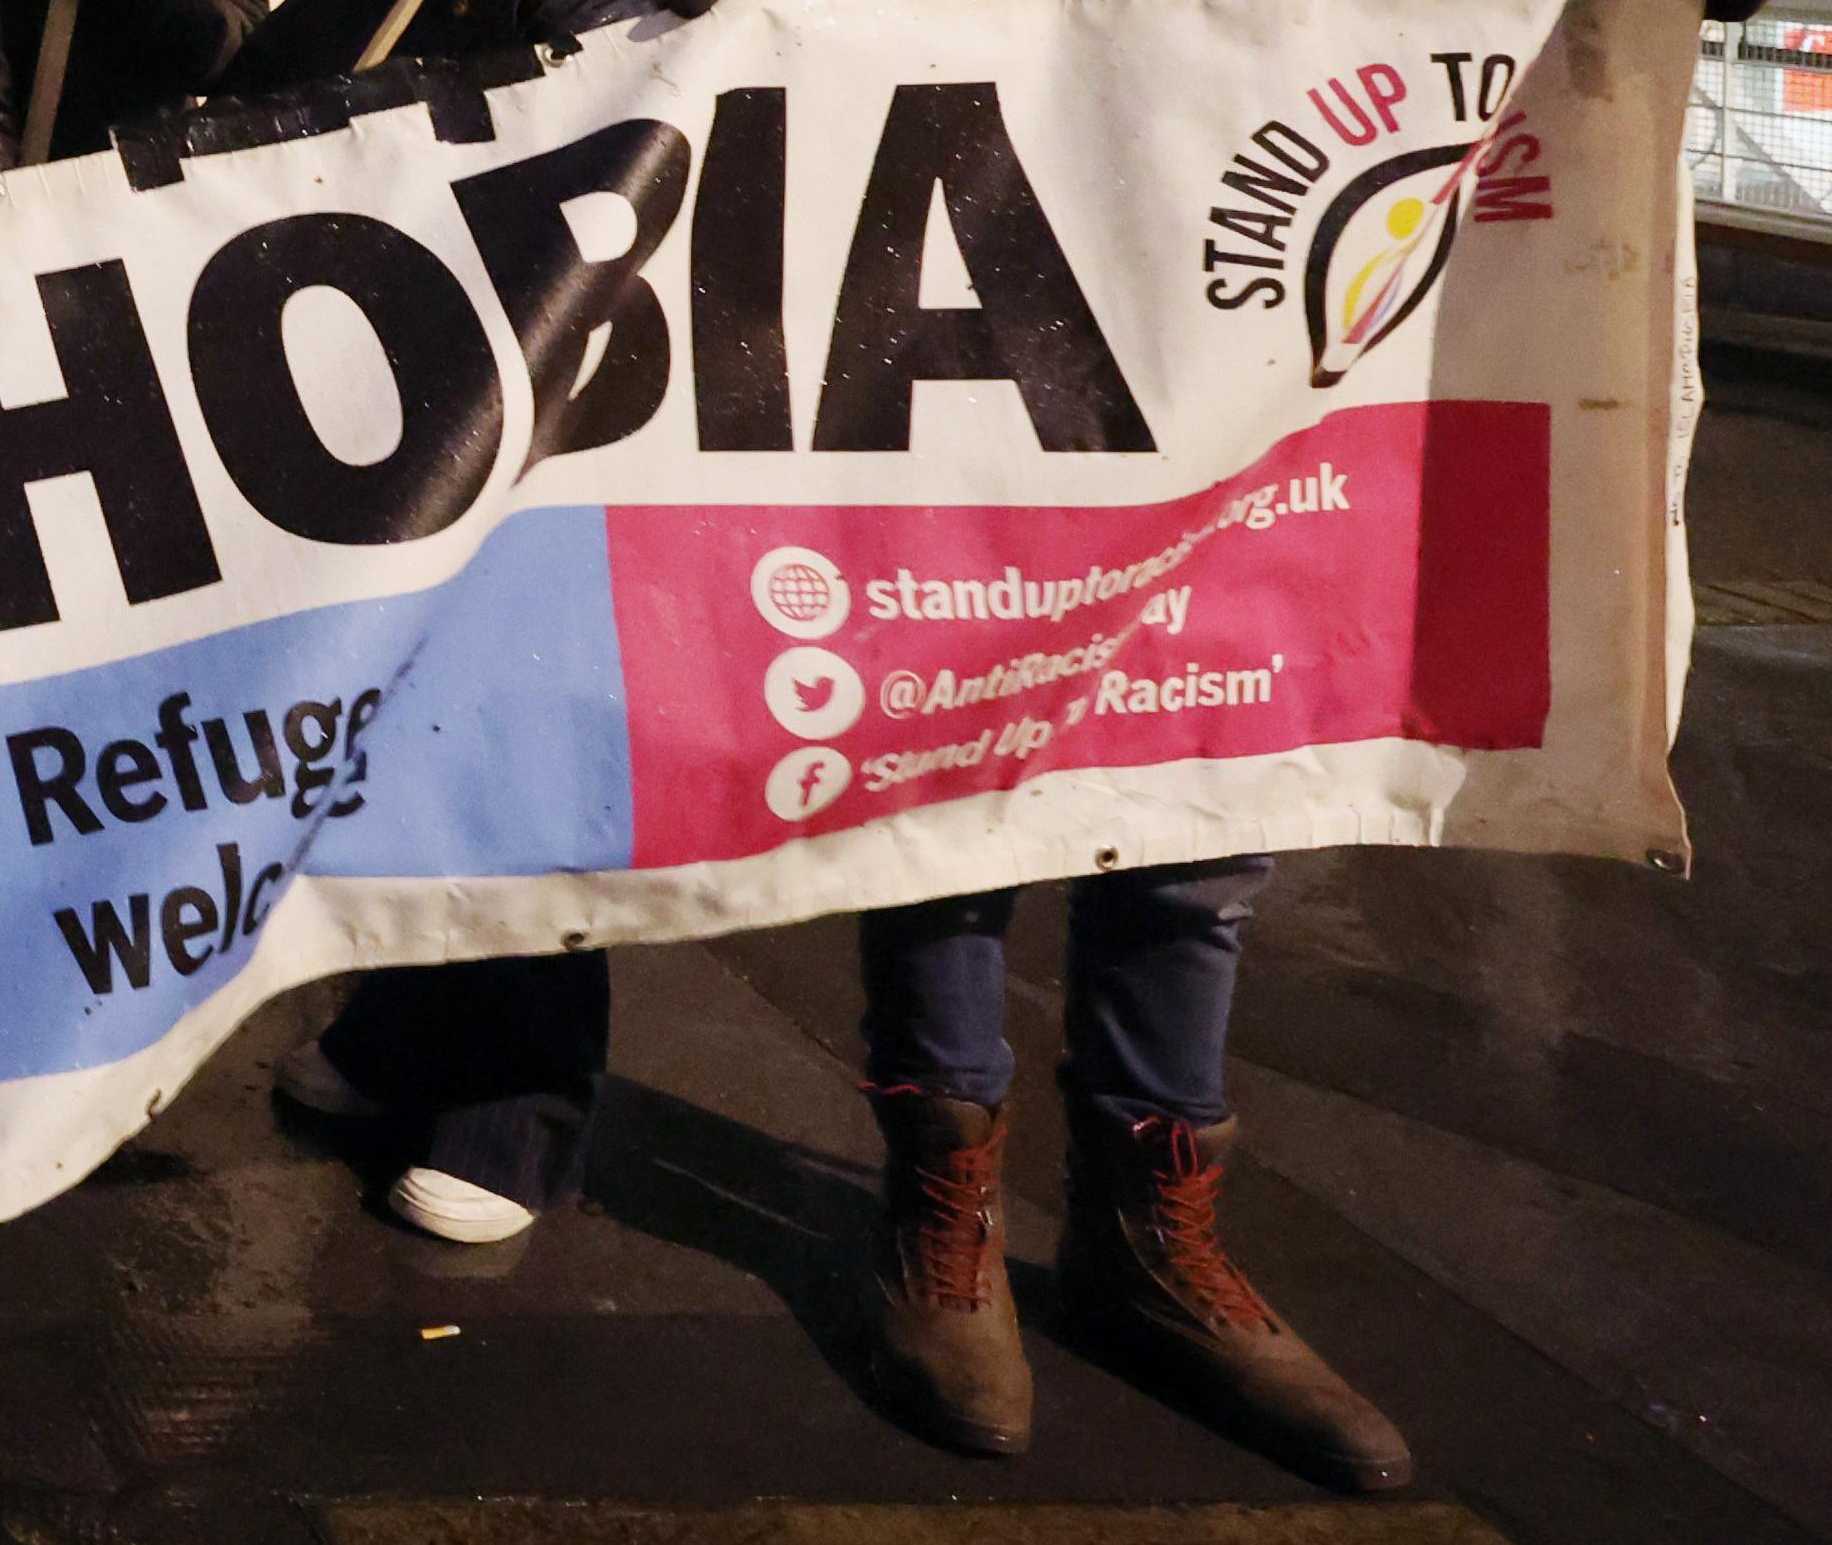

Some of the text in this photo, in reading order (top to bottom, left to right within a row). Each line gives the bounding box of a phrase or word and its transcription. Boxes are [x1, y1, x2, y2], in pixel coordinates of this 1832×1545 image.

[1202, 120, 1331, 311] STAND
[1307, 63, 1408, 147] UP
[1430, 52, 1516, 122] TO
[993, 715, 1054, 760] Up
